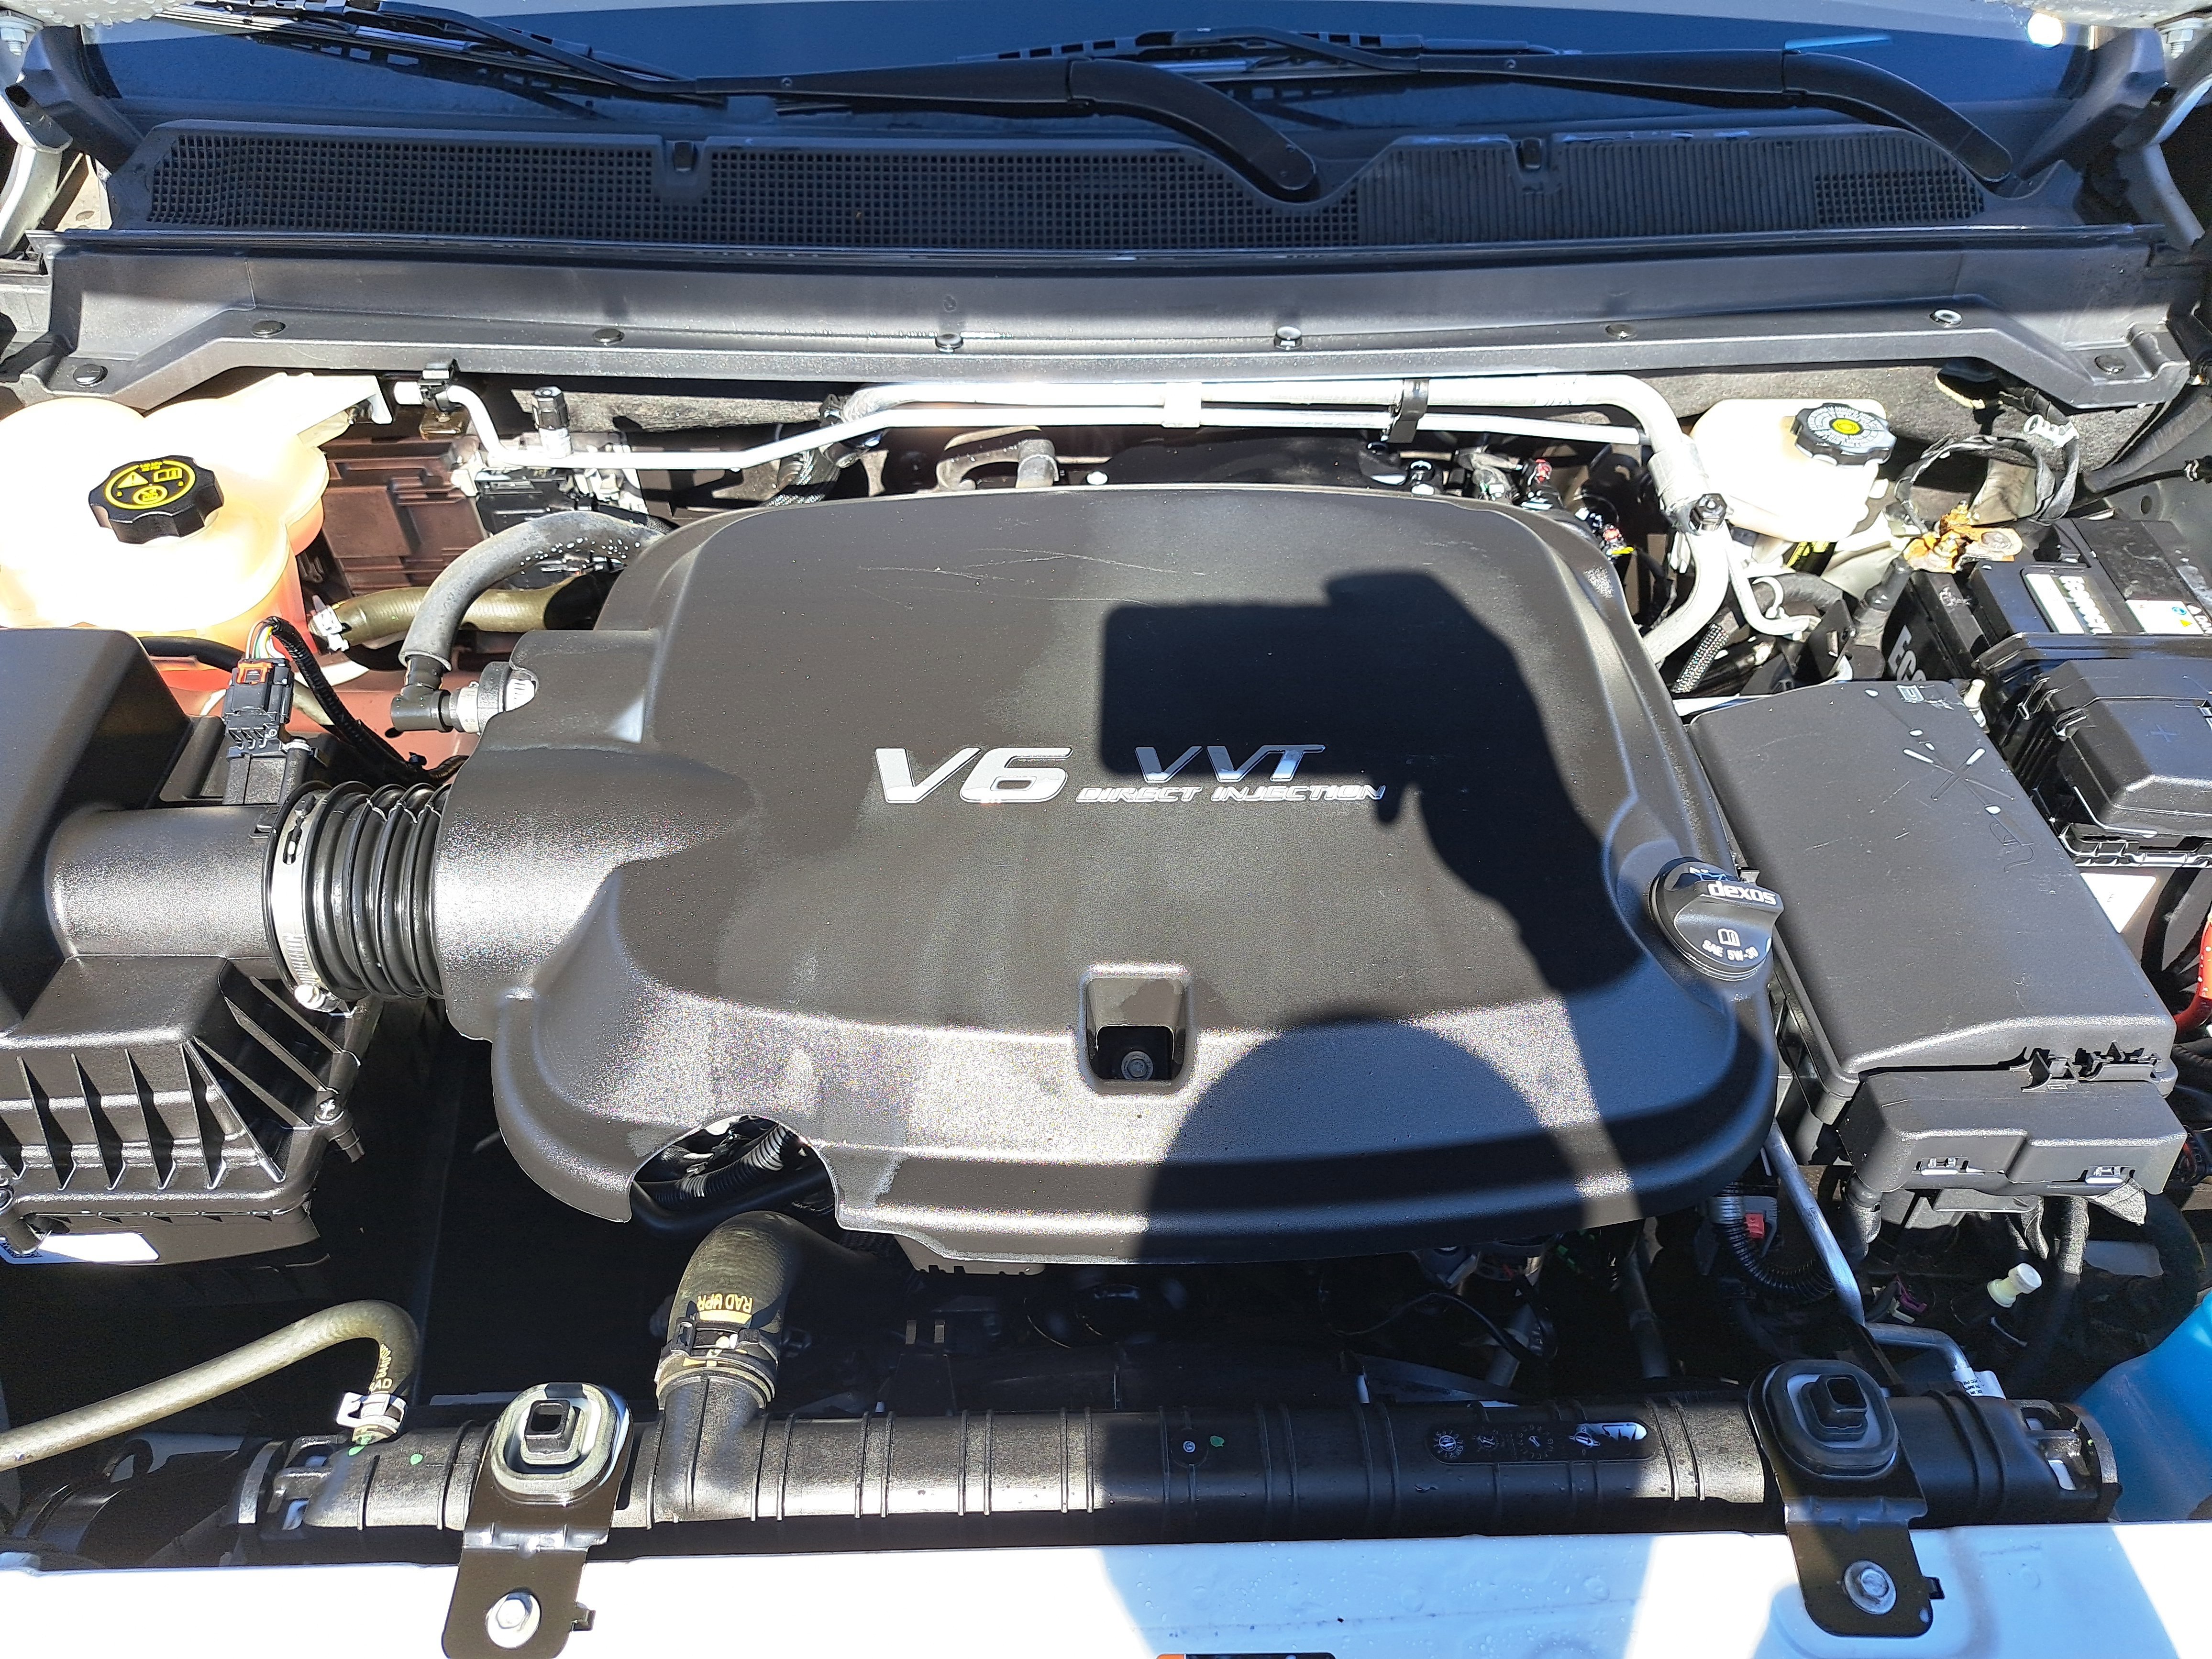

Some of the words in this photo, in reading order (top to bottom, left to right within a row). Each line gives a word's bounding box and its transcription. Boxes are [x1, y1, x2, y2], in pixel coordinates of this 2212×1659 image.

[1134, 744, 1326, 783] VVT
[875, 747, 1073, 803] V6
[1076, 786, 1203, 802] DIRECT
[1211, 784, 1386, 802] INJECTION
[1708, 880, 1777, 905] dexos
[1702, 940, 1723, 957] SAE
[1727, 946, 1759, 961] 5W-30
[697, 1293, 723, 1312] UPR
[725, 1294, 752, 1313] RAD
